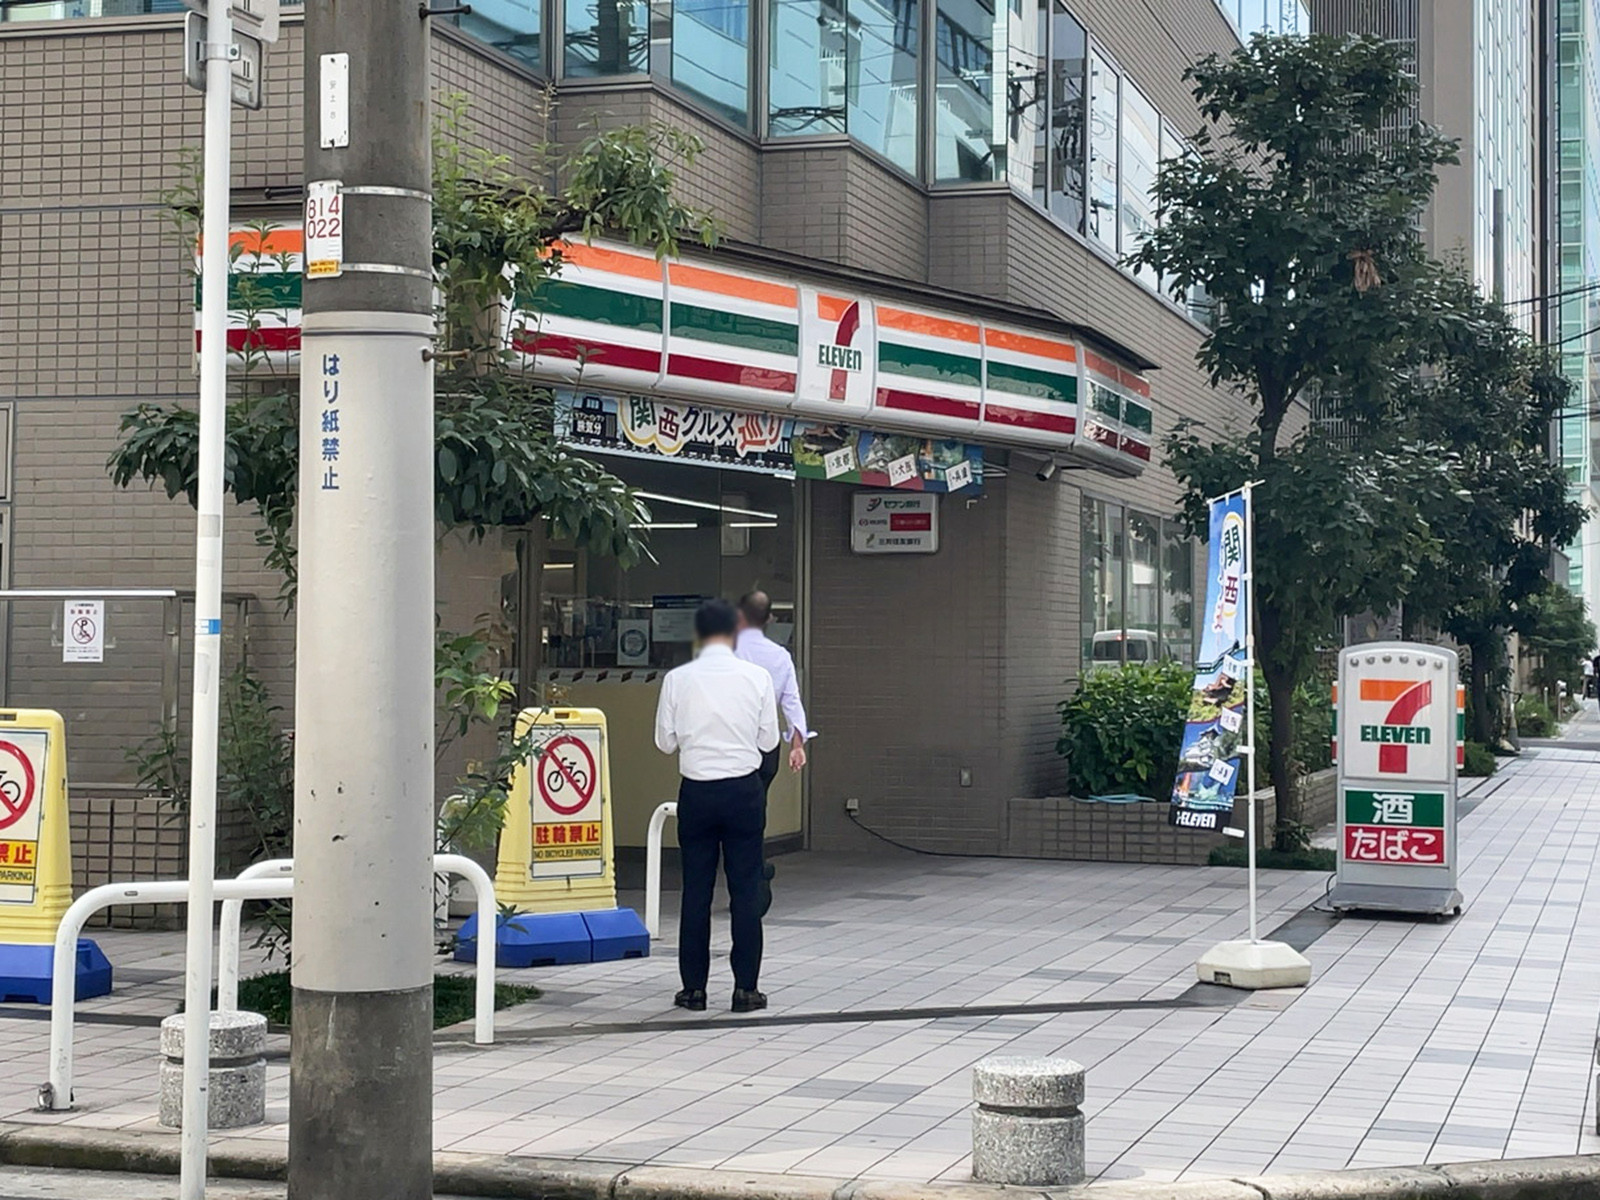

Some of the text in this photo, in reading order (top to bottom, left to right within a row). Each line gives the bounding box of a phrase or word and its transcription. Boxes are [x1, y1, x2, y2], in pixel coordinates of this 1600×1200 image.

[307, 195, 340, 219] 814
[307, 217, 341, 239] 022
[321, 353, 340, 490] はり紙禁止
[629, 395, 783, 451] 関西グルメ巡り
[1372, 792, 1415, 824] 酒
[535, 824, 599, 844] 駐輪禁止
[1351, 828, 1438, 862] たばこ
